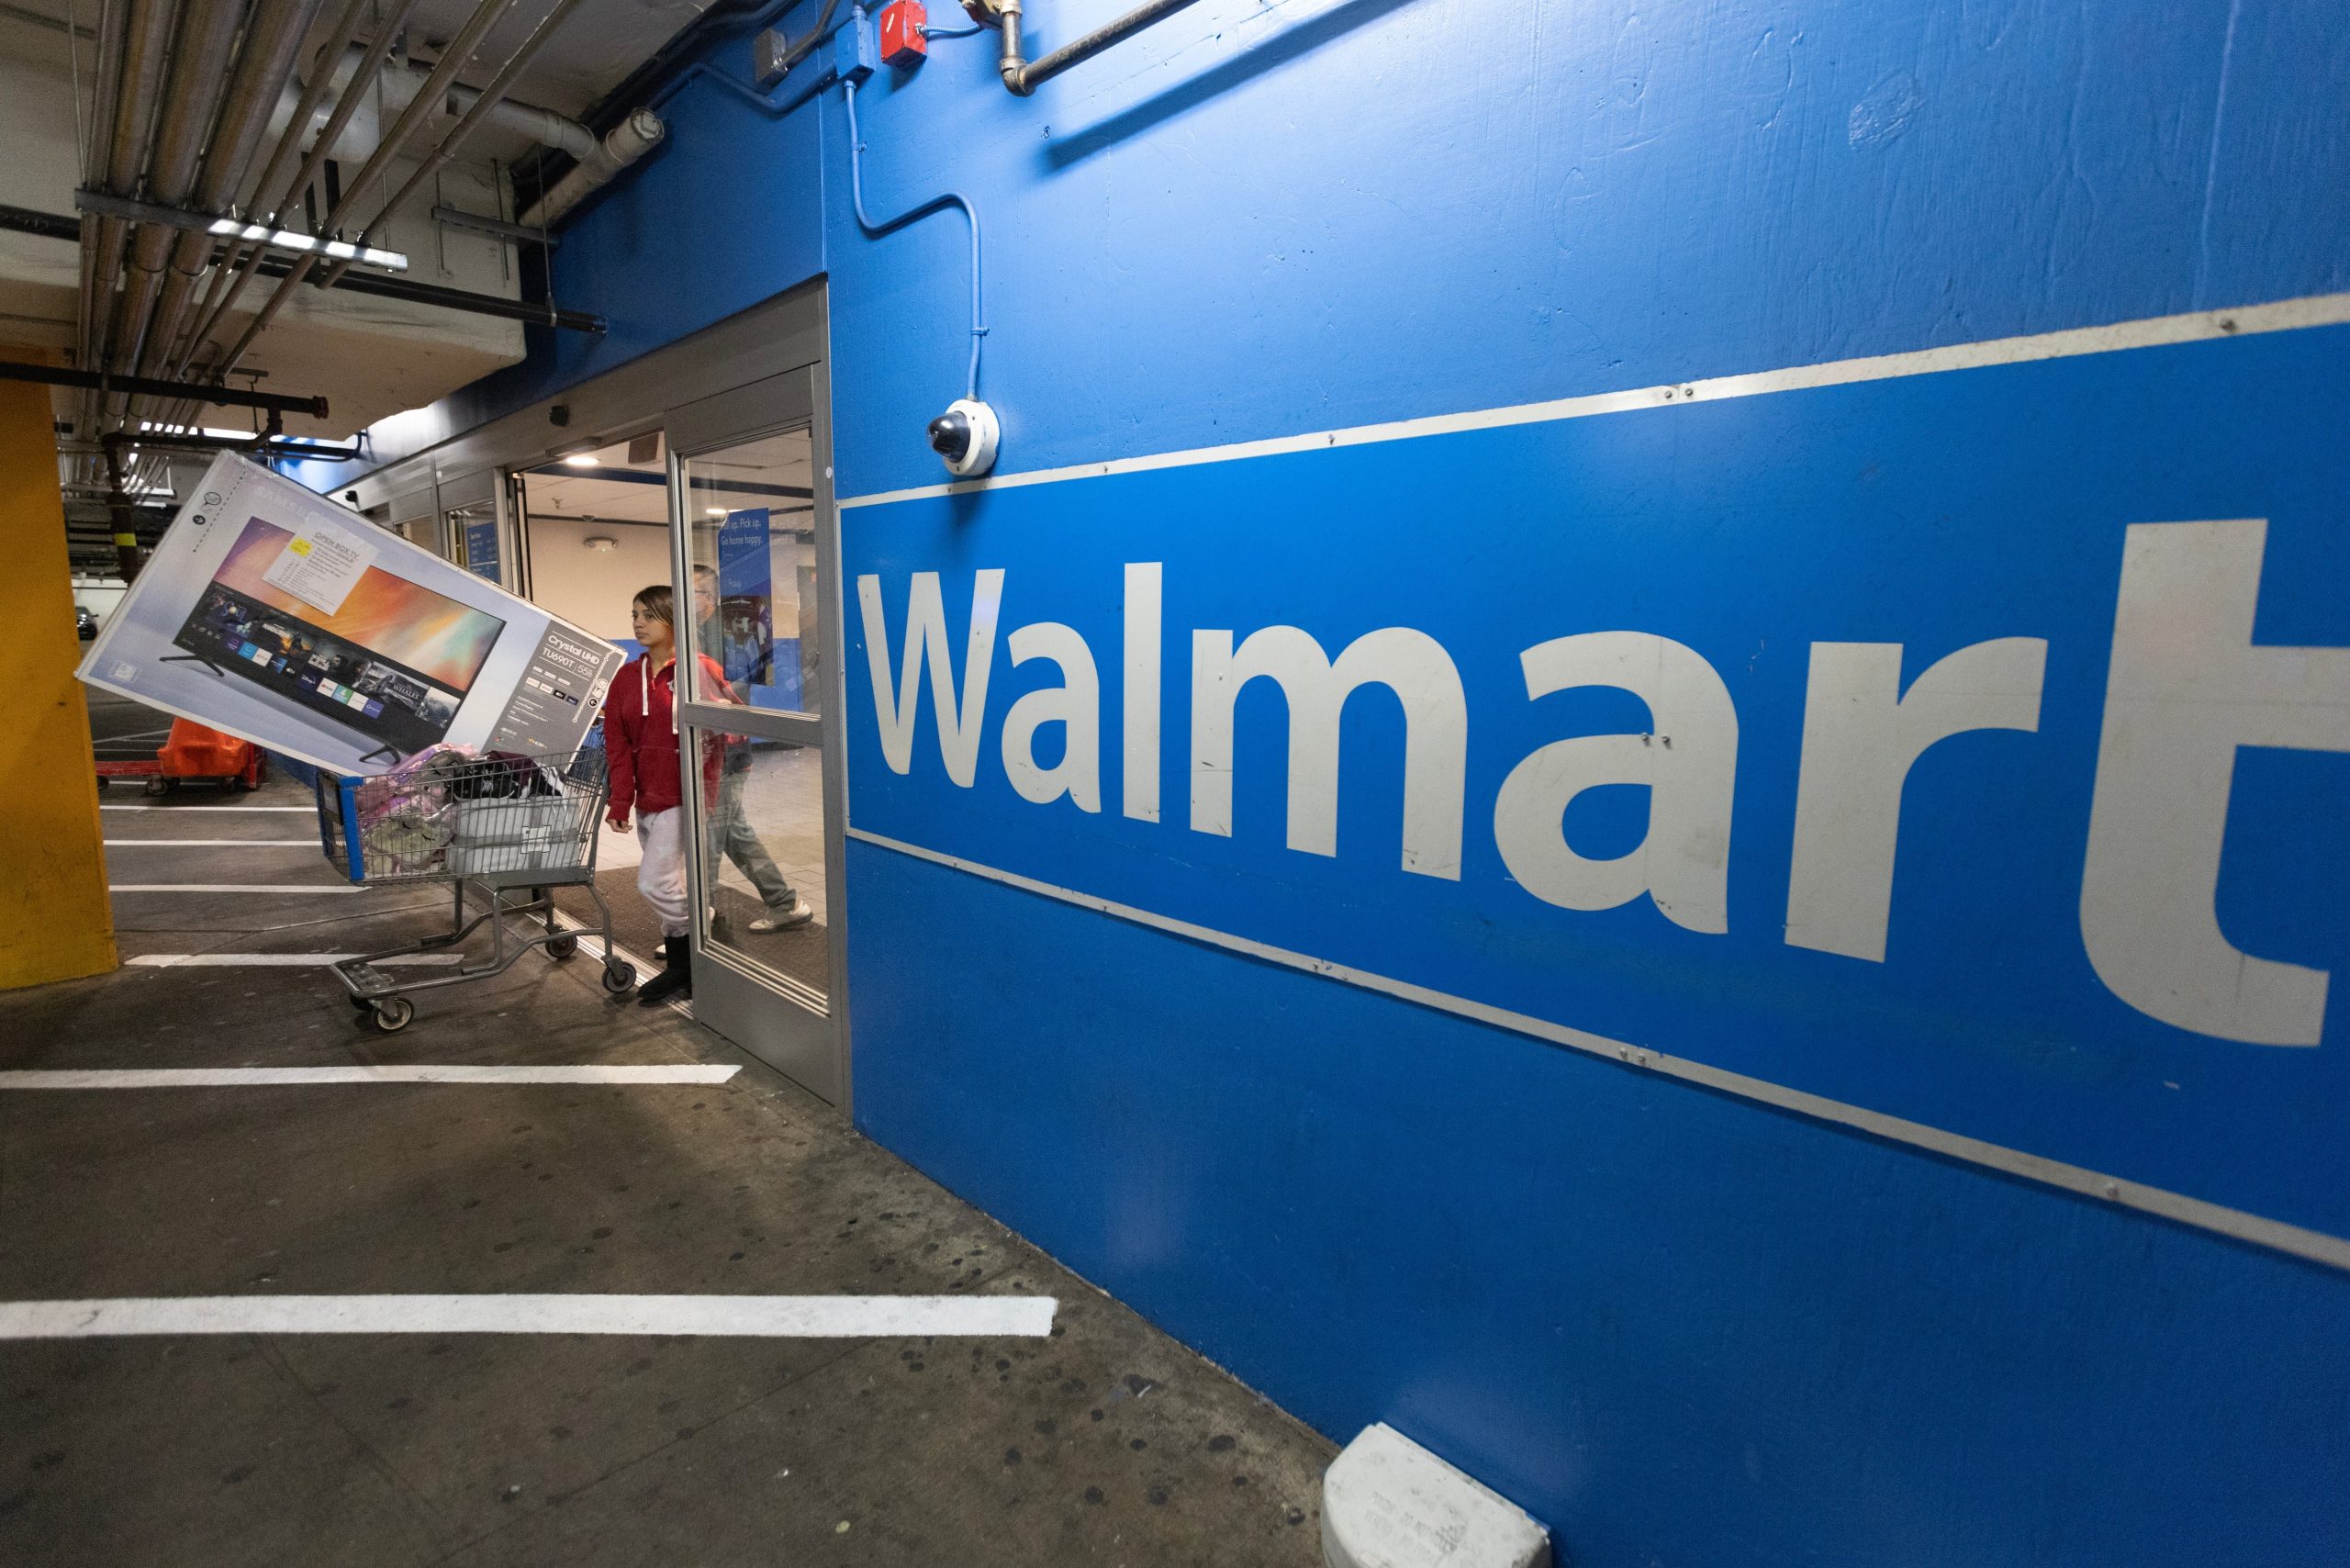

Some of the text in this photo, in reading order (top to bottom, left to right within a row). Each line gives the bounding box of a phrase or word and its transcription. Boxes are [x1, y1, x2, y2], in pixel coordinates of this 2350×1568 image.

[254, 486, 308, 516] SAMSU
[740, 518, 751, 529] Pick
[753, 520, 761, 530] up.
[315, 532, 360, 558] OPEN BOX TV
[721, 535, 728, 544] Go
[730, 535, 744, 544] home
[543, 646, 575, 667] TU690T
[548, 634, 599, 664] Crystal UHD
[393, 684, 419, 700] WHALES
[856, 519, 2350, 1047] Walmart
